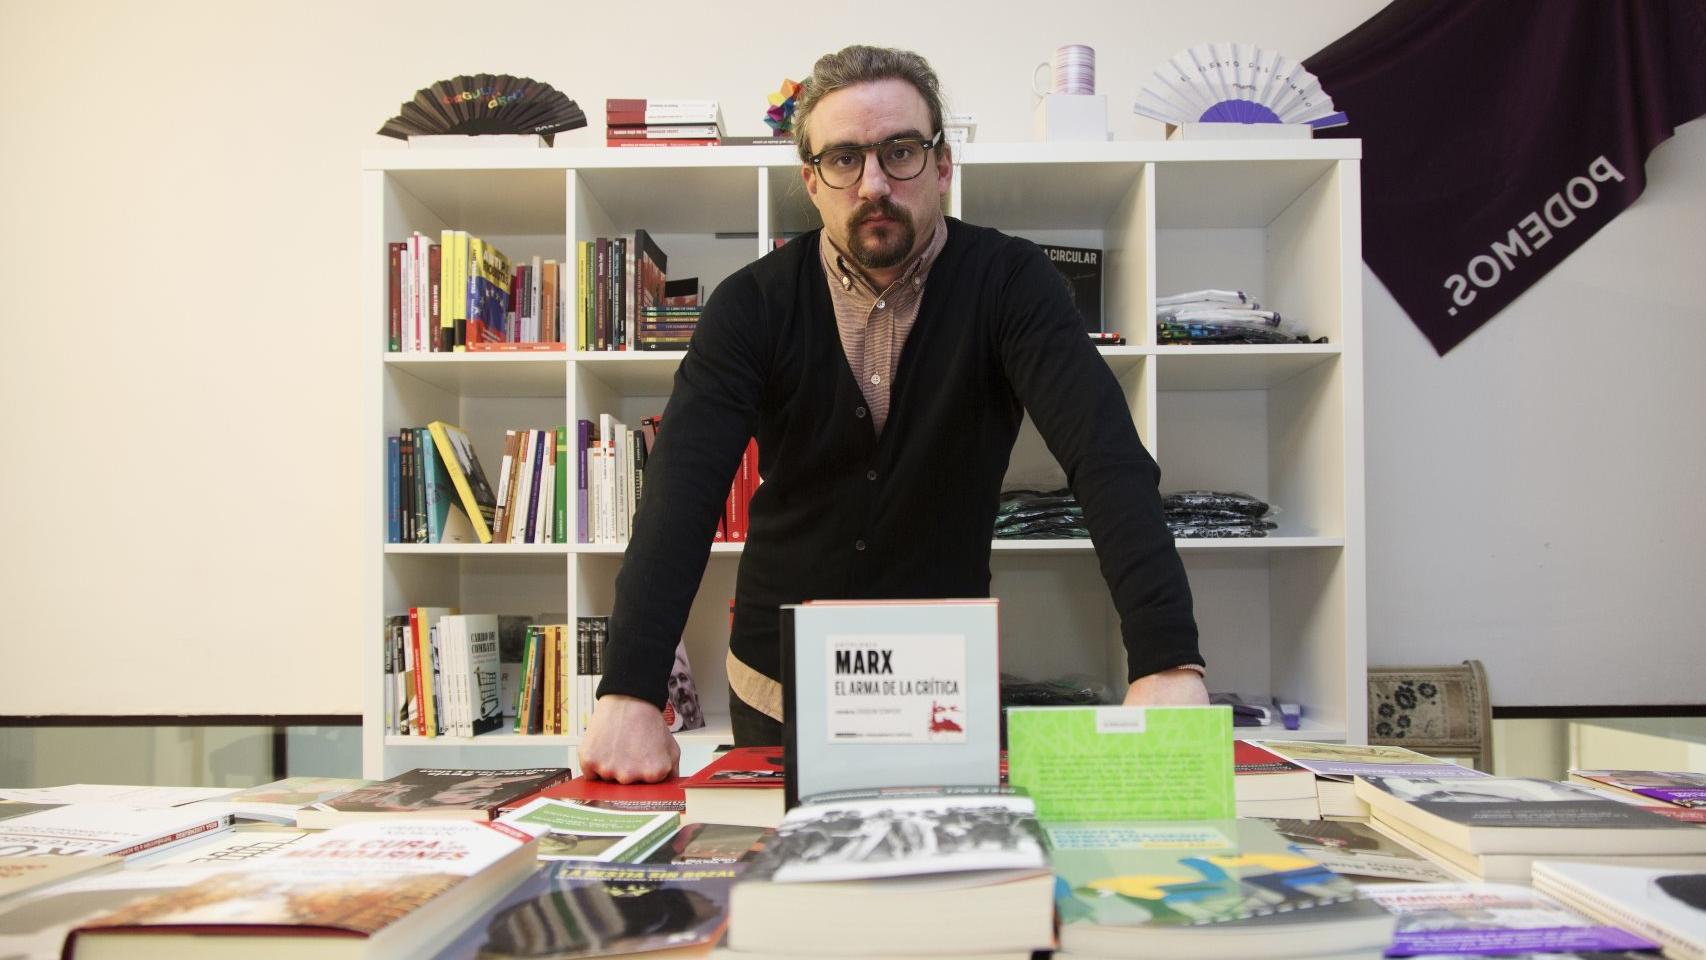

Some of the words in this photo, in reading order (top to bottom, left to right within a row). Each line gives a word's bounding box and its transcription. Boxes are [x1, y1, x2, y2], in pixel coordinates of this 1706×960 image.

[1050, 249, 1097, 264] CIRCULAR
[835, 650, 894, 675] MARX
[834, 681, 847, 696] EL
[849, 681, 880, 696] ARMA
[883, 681, 896, 696] DE
[899, 681, 913, 696] LA
[915, 677, 960, 696] CRÍTICA
